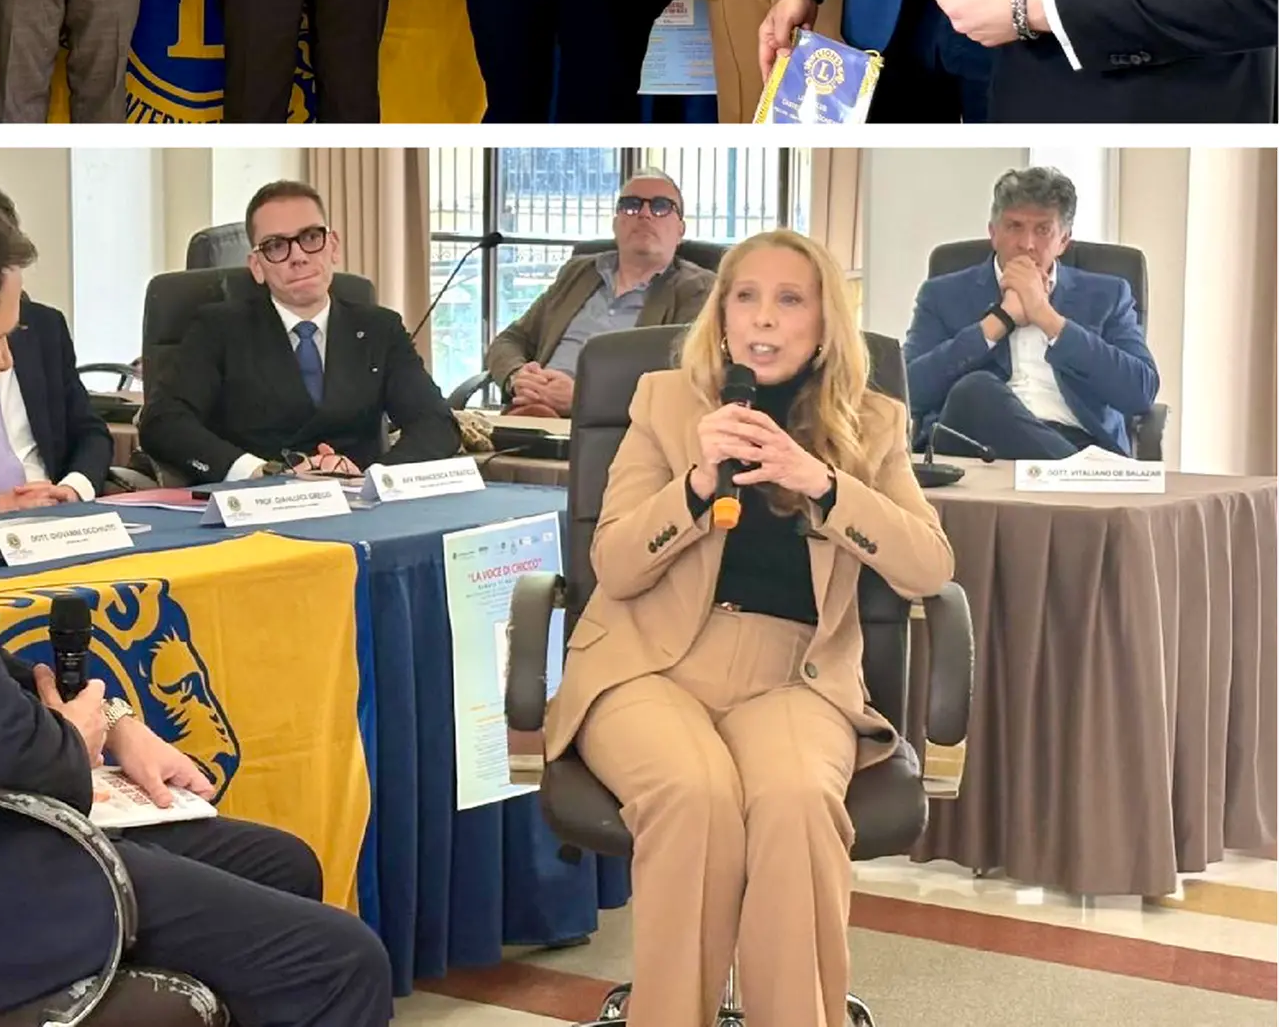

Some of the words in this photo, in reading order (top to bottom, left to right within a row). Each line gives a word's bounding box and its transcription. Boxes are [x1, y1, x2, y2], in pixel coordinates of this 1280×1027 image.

[817, 62, 829, 80] L
[1071, 469, 1111, 477] VITALIANO
[1113, 469, 1124, 477] DE
